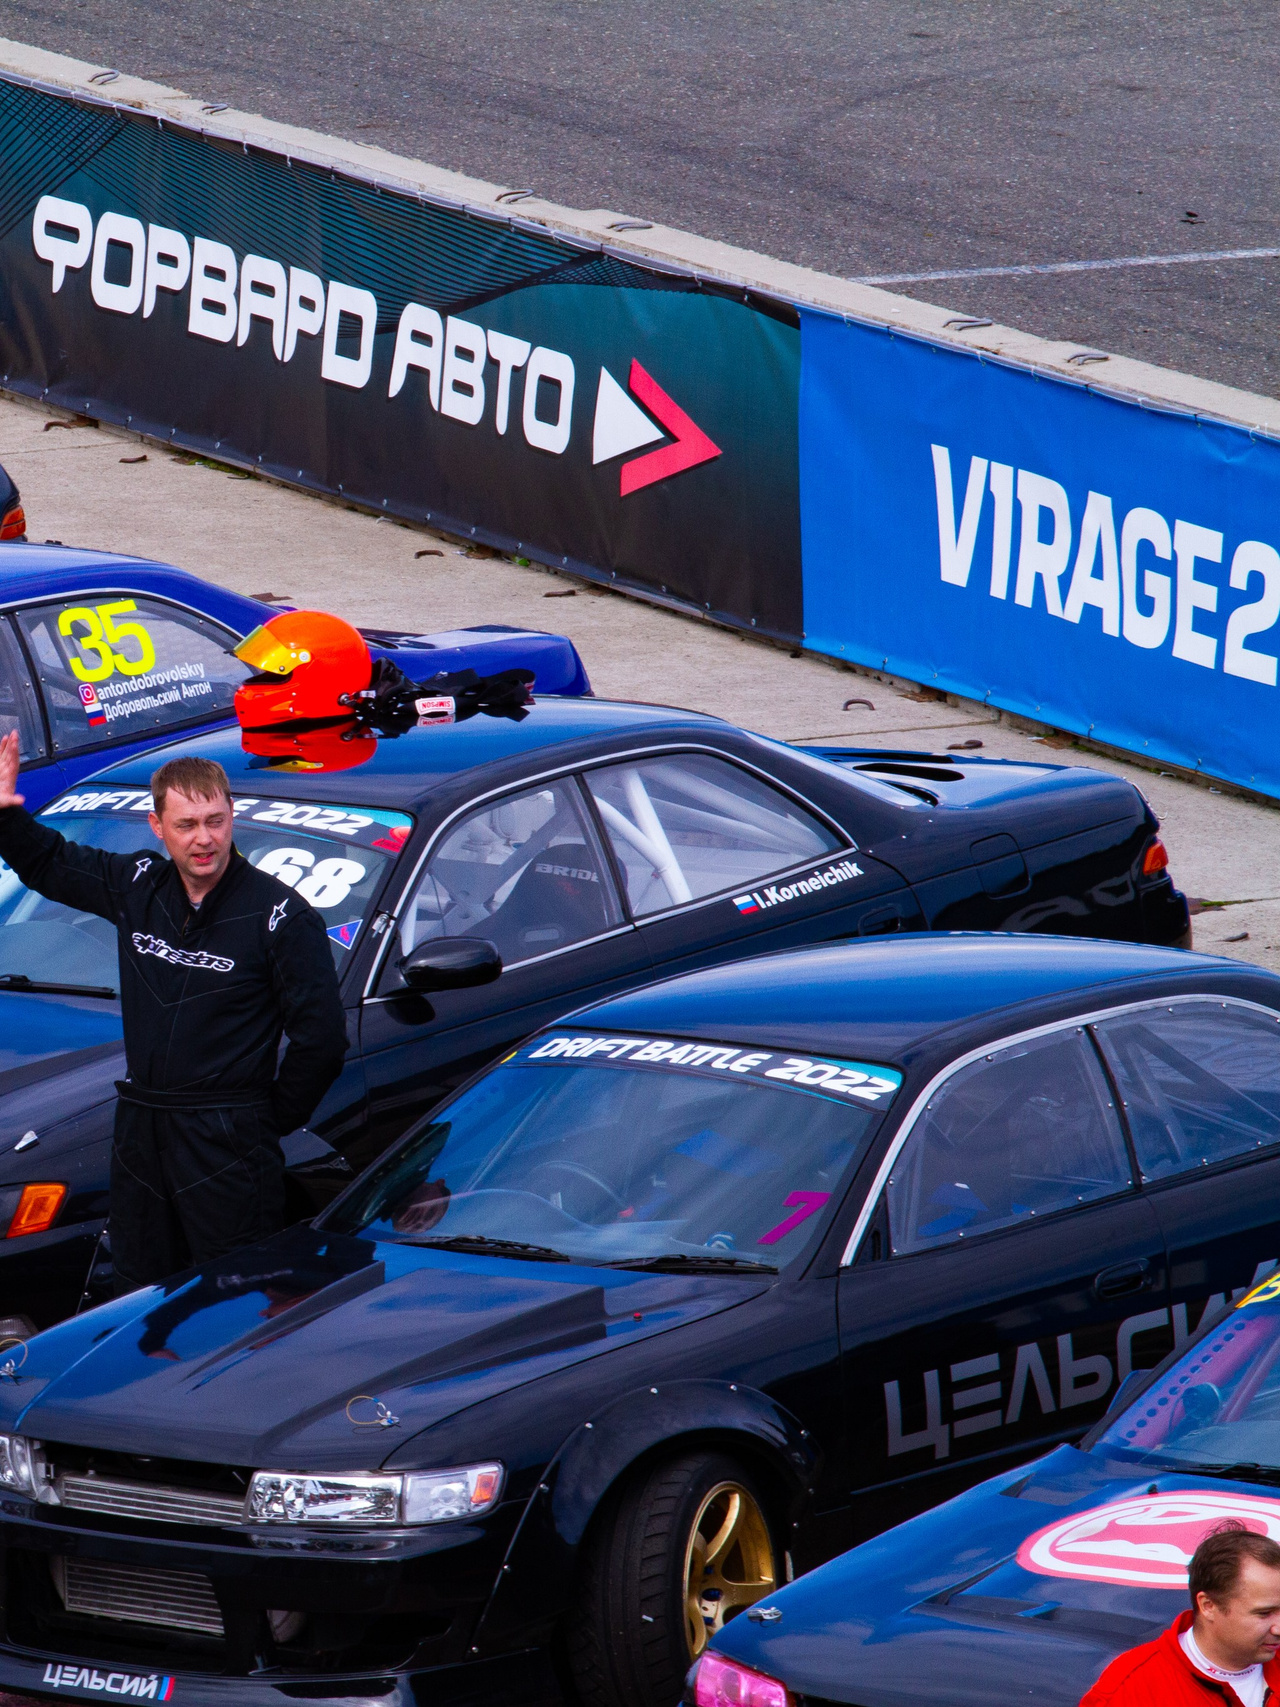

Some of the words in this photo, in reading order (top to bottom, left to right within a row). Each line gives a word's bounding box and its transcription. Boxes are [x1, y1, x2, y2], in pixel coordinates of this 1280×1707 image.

[388, 303, 576, 455] АВТО
[58, 599, 156, 683] 35
[97, 662, 205, 701] antondobrovolskiy
[103, 686, 181, 722] Добровольский
[181, 681, 212, 700] Антон
[252, 802, 373, 835] 2022
[255, 847, 366, 908] 68
[752, 861, 864, 909] I.Korneichik
[764, 1057, 899, 1101] 2022
[758, 1190, 832, 1245] 7
[42, 1663, 159, 1699] ЦЕЛЬСИЙ
